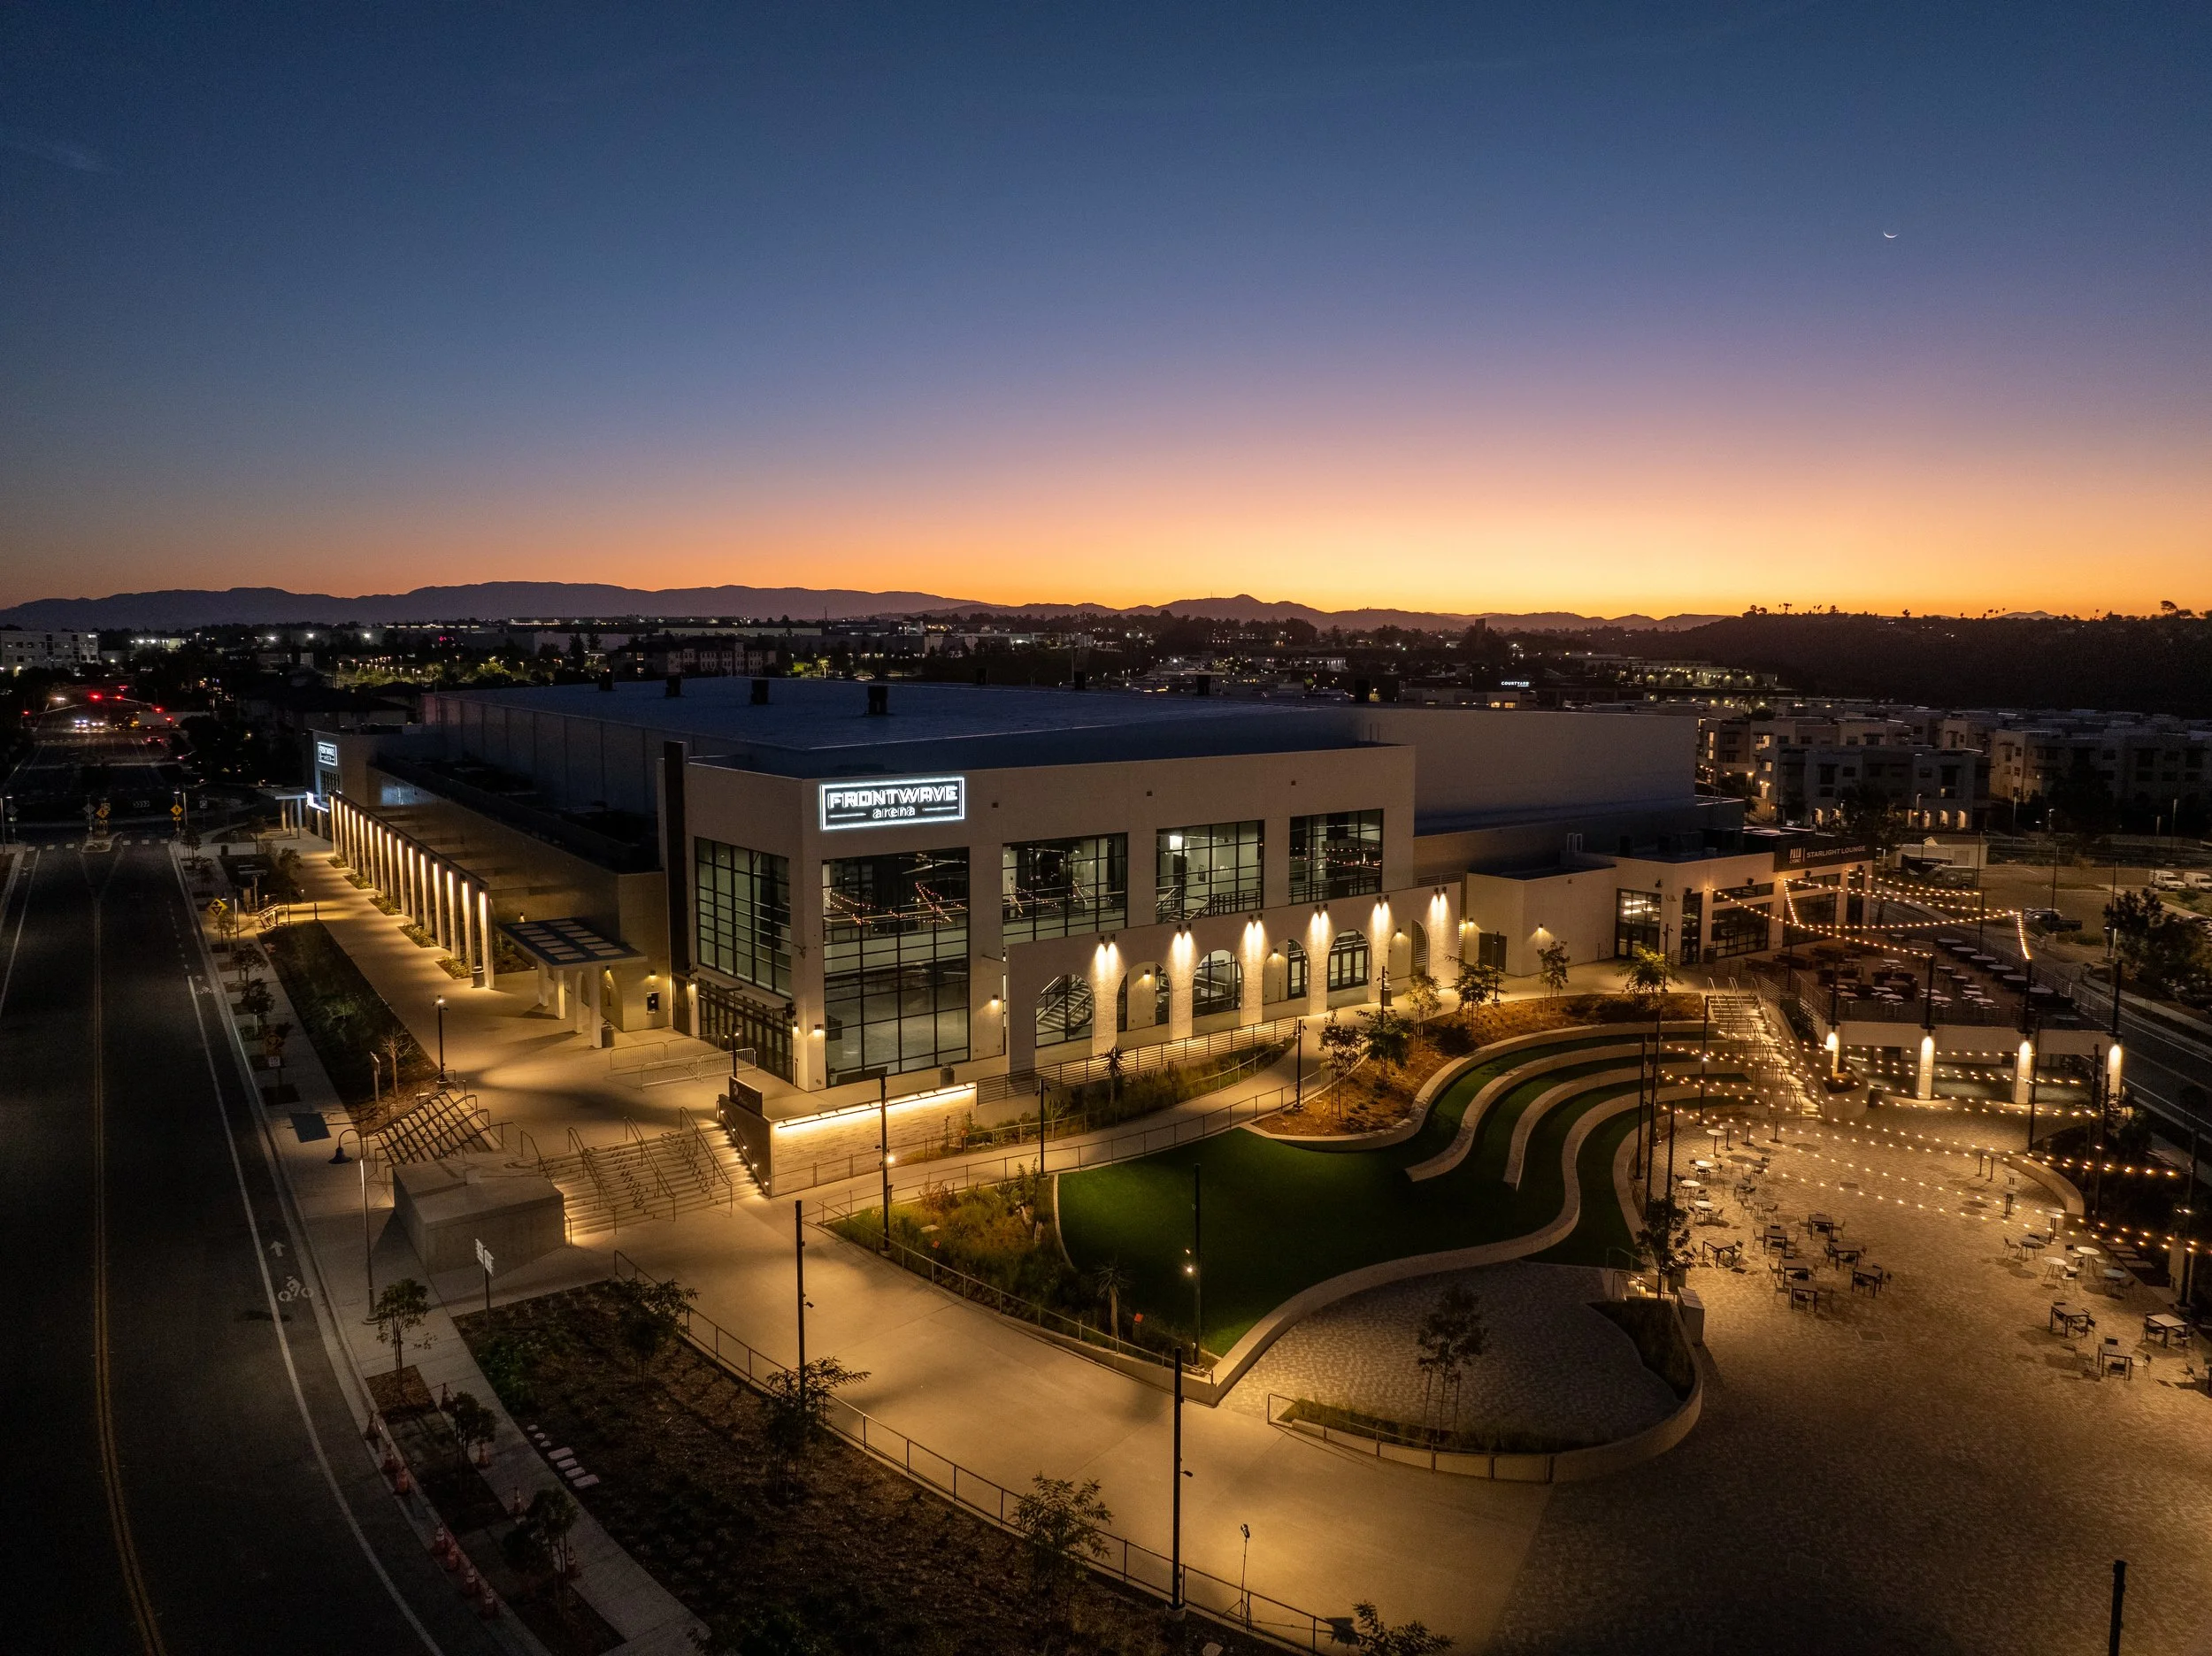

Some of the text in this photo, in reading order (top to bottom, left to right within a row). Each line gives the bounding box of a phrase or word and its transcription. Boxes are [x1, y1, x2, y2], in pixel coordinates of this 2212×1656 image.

[827, 786, 958, 809] FRONTWAVE
[873, 806, 915, 819] arena
[1806, 848, 1840, 858] STARLIGHT
[1840, 845, 1867, 854] LOUNGE
